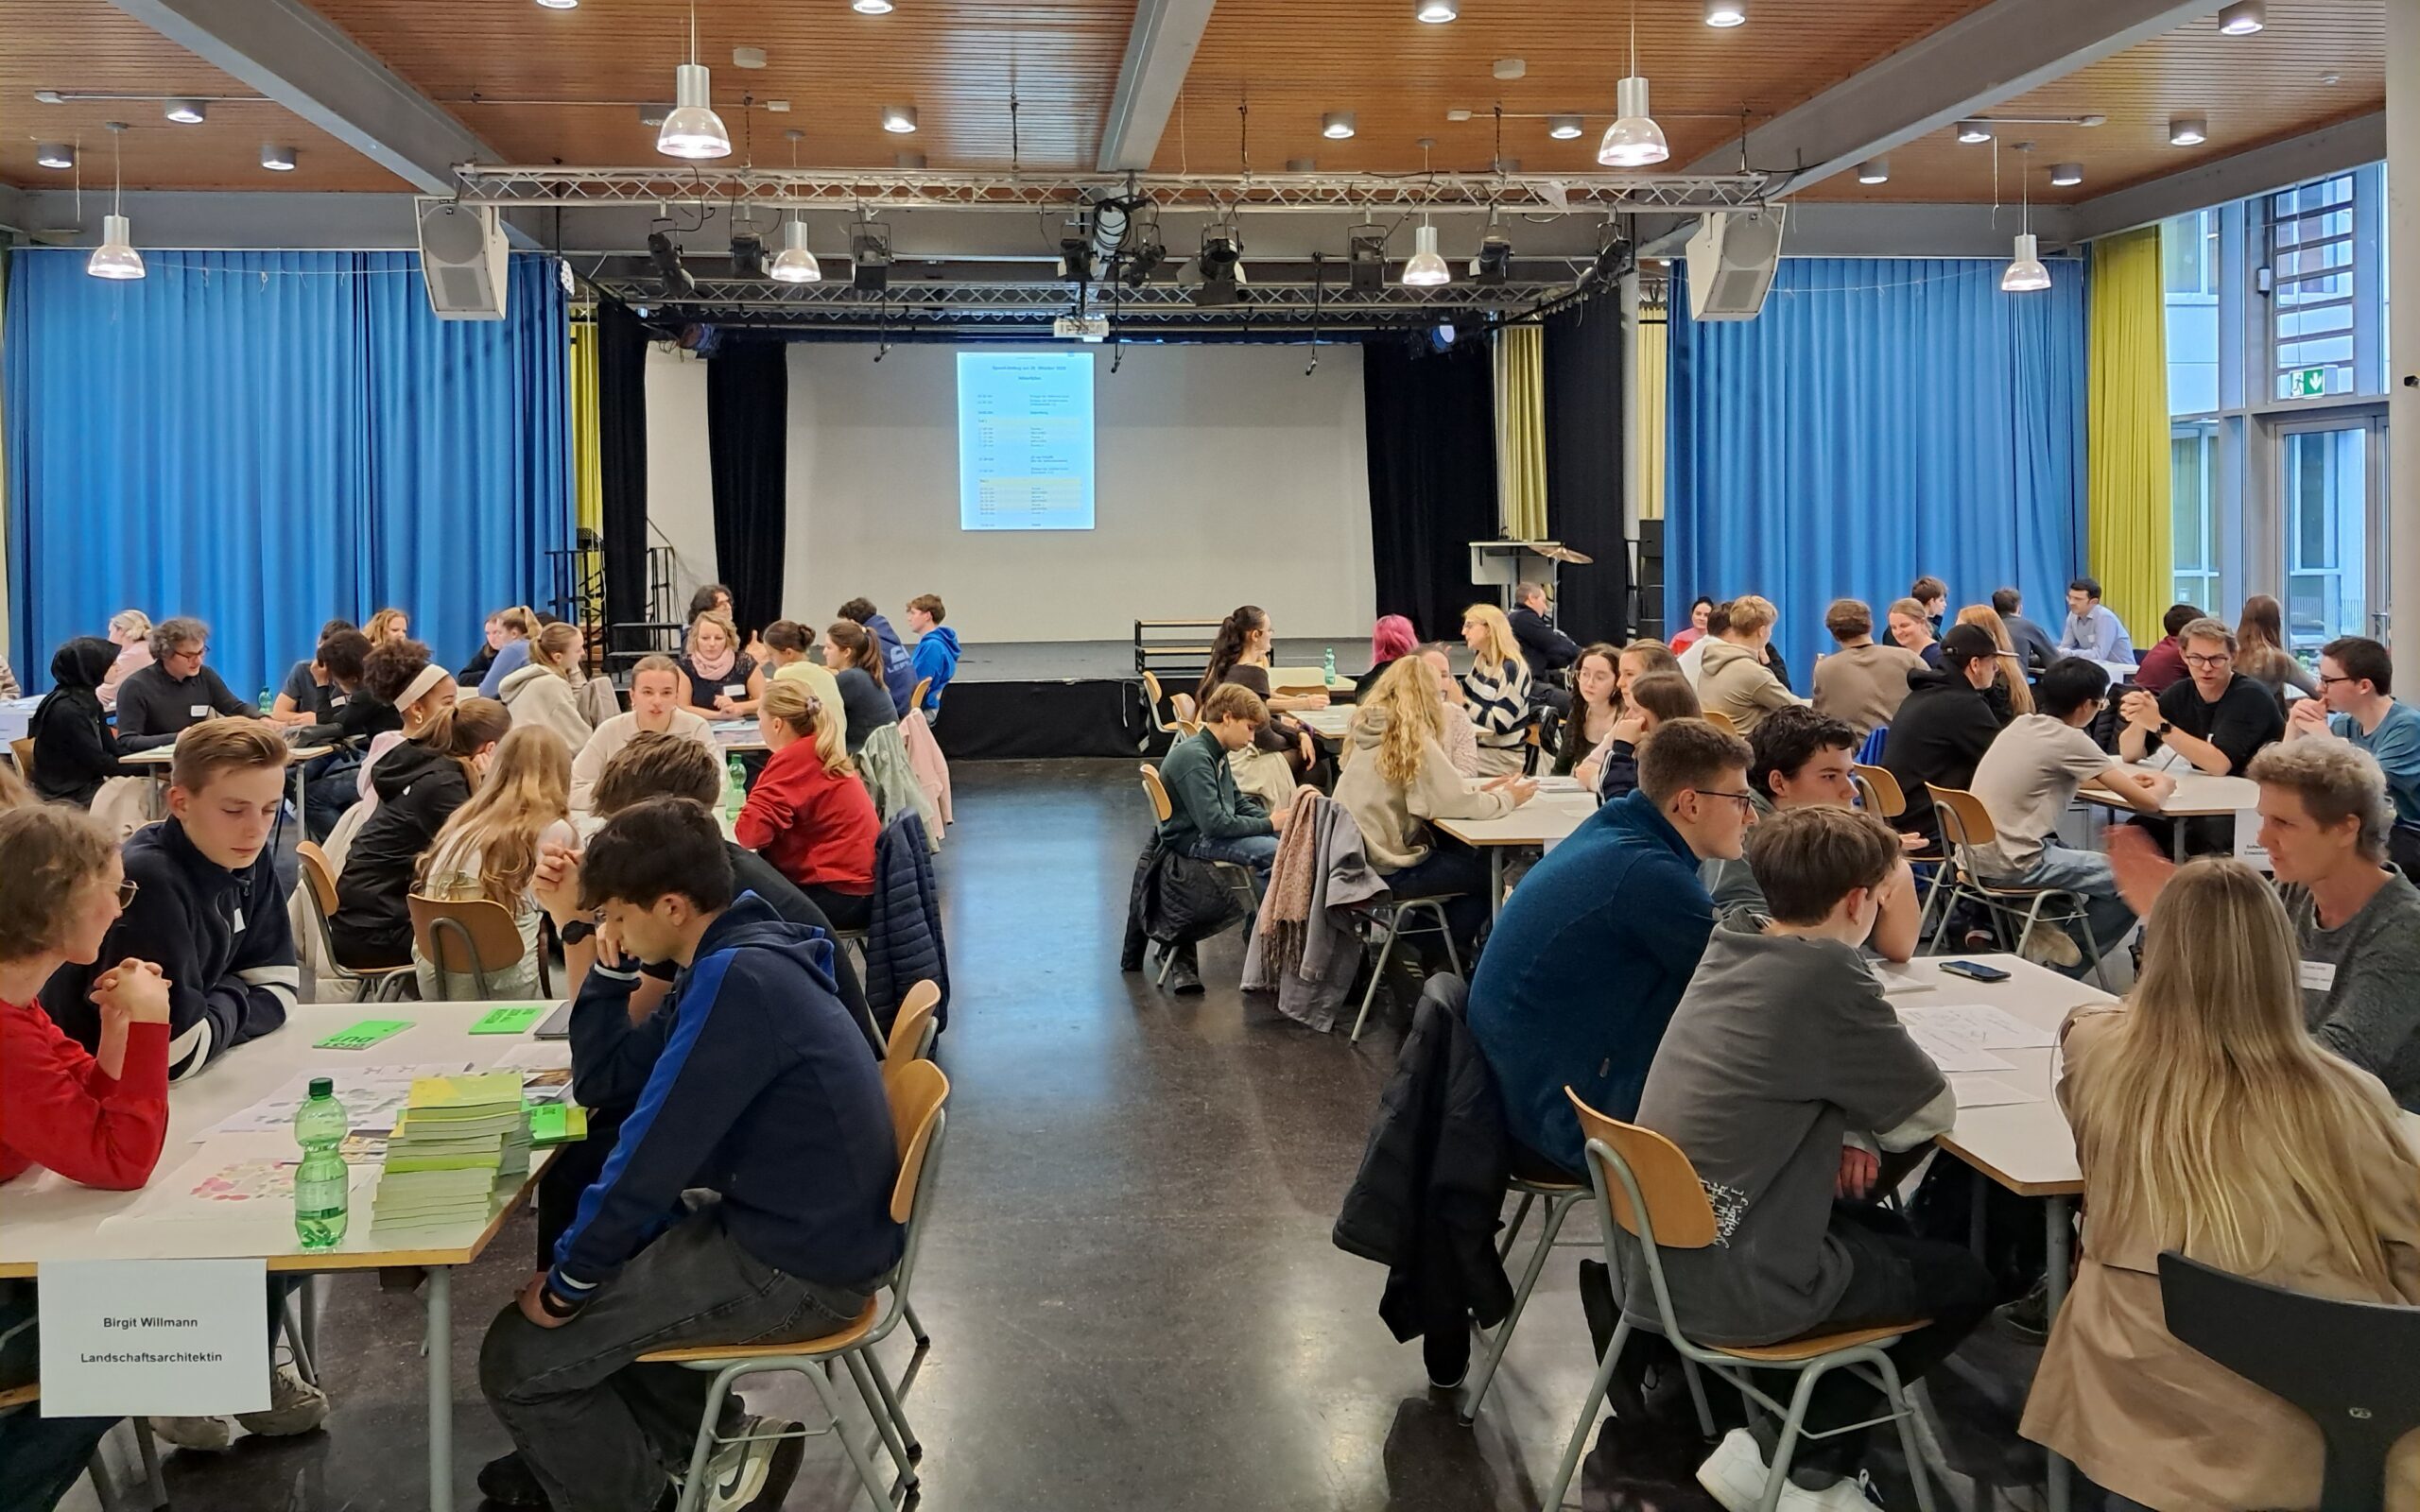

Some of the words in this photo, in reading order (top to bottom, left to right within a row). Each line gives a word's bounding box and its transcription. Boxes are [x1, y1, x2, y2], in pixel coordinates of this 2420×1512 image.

[103, 1317, 138, 1330] Birgit
[140, 1317, 199, 1328] Willmann
[80, 1352, 223, 1363] Landschaftsarchitektin
